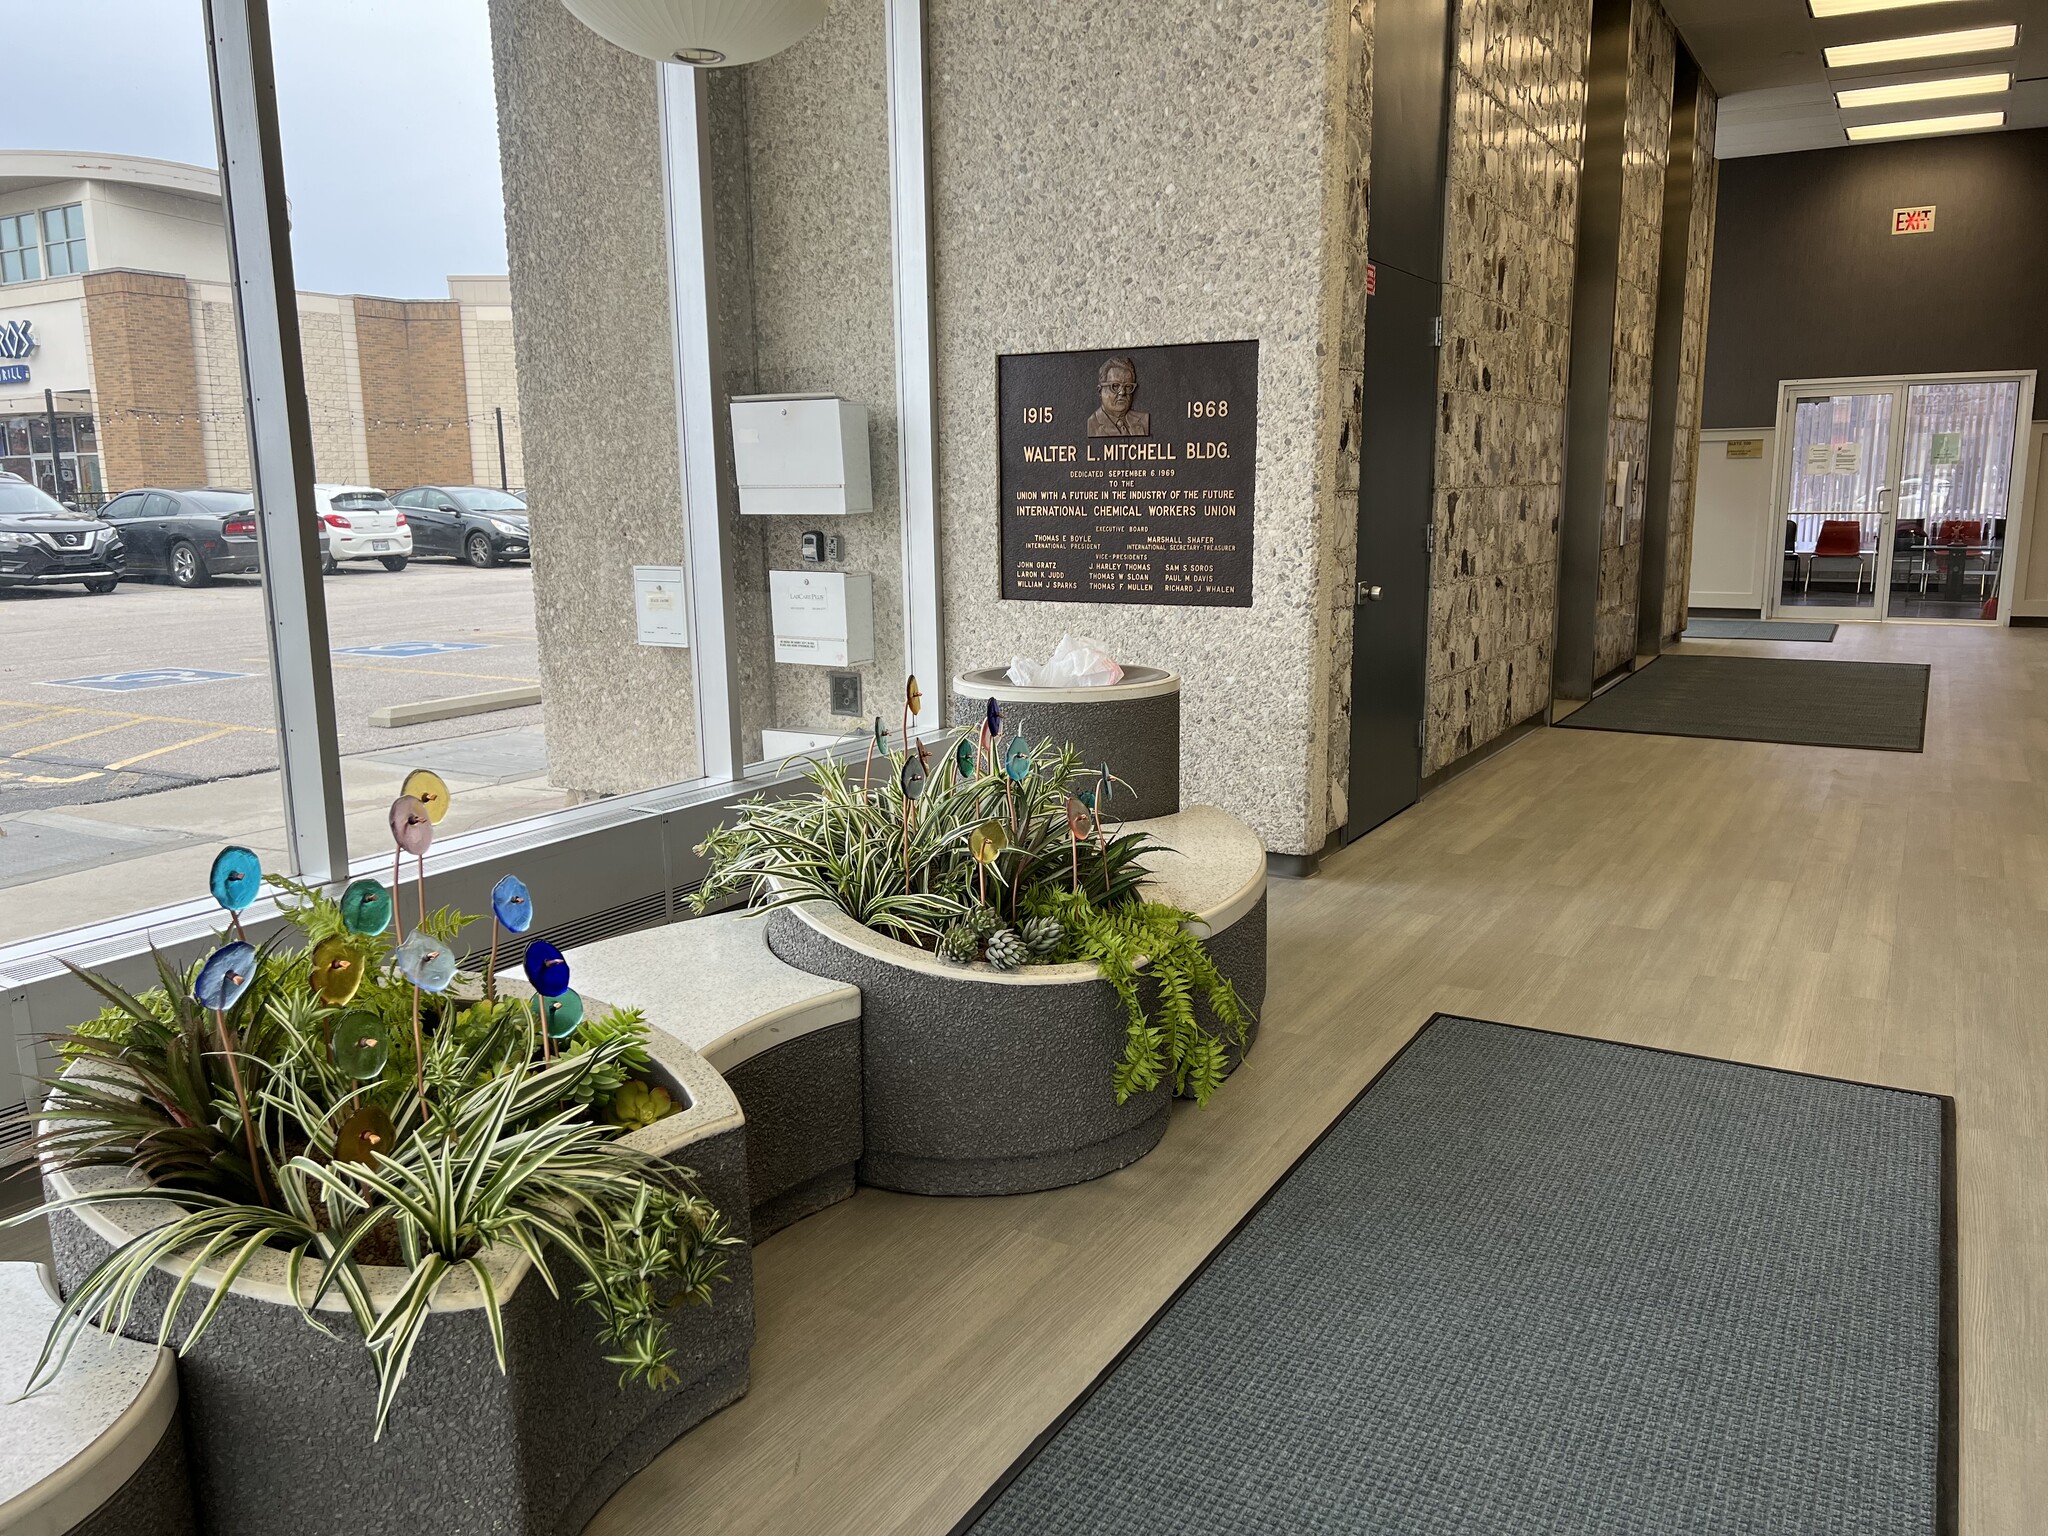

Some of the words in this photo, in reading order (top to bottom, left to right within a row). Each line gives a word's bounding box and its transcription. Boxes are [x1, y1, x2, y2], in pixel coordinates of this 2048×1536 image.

[1896, 210, 1931, 231] EXIT
[0, 367, 22, 381] RILL
[1023, 407, 1053, 424] 1915
[1187, 401, 1228, 418] 1968
[1023, 446, 1077, 462] WALTER
[1087, 445, 1100, 461] L.
[1104, 443, 1176, 461] MITCHELL
[1186, 441, 1231, 459] BLDG.
[1070, 470, 1104, 478] DEDICATED
[1108, 470, 1147, 478] SEPTEMBER
[1016, 492, 1037, 500] UNION
[1041, 492, 1058, 500] WITH
[1061, 492, 1067, 500] A
[1070, 491, 1098, 500] FUTURE
[1102, 491, 1109, 499] IN
[1112, 491, 1127, 499] THE
[1130, 490, 1167, 499] INDUSTRY
[1170, 490, 1181, 499] OF
[1184, 490, 1199, 499] THE
[1202, 490, 1235, 499] FUTURE
[1016, 506, 1088, 516] INTERNATIONAL
[1094, 506, 1142, 516] CHEMICAL
[1148, 506, 1196, 516] WORKERS
[1204, 505, 1236, 516] UNION
[1187, 536, 1214, 544] SHAFER
[1165, 564, 1179, 572] SAM
